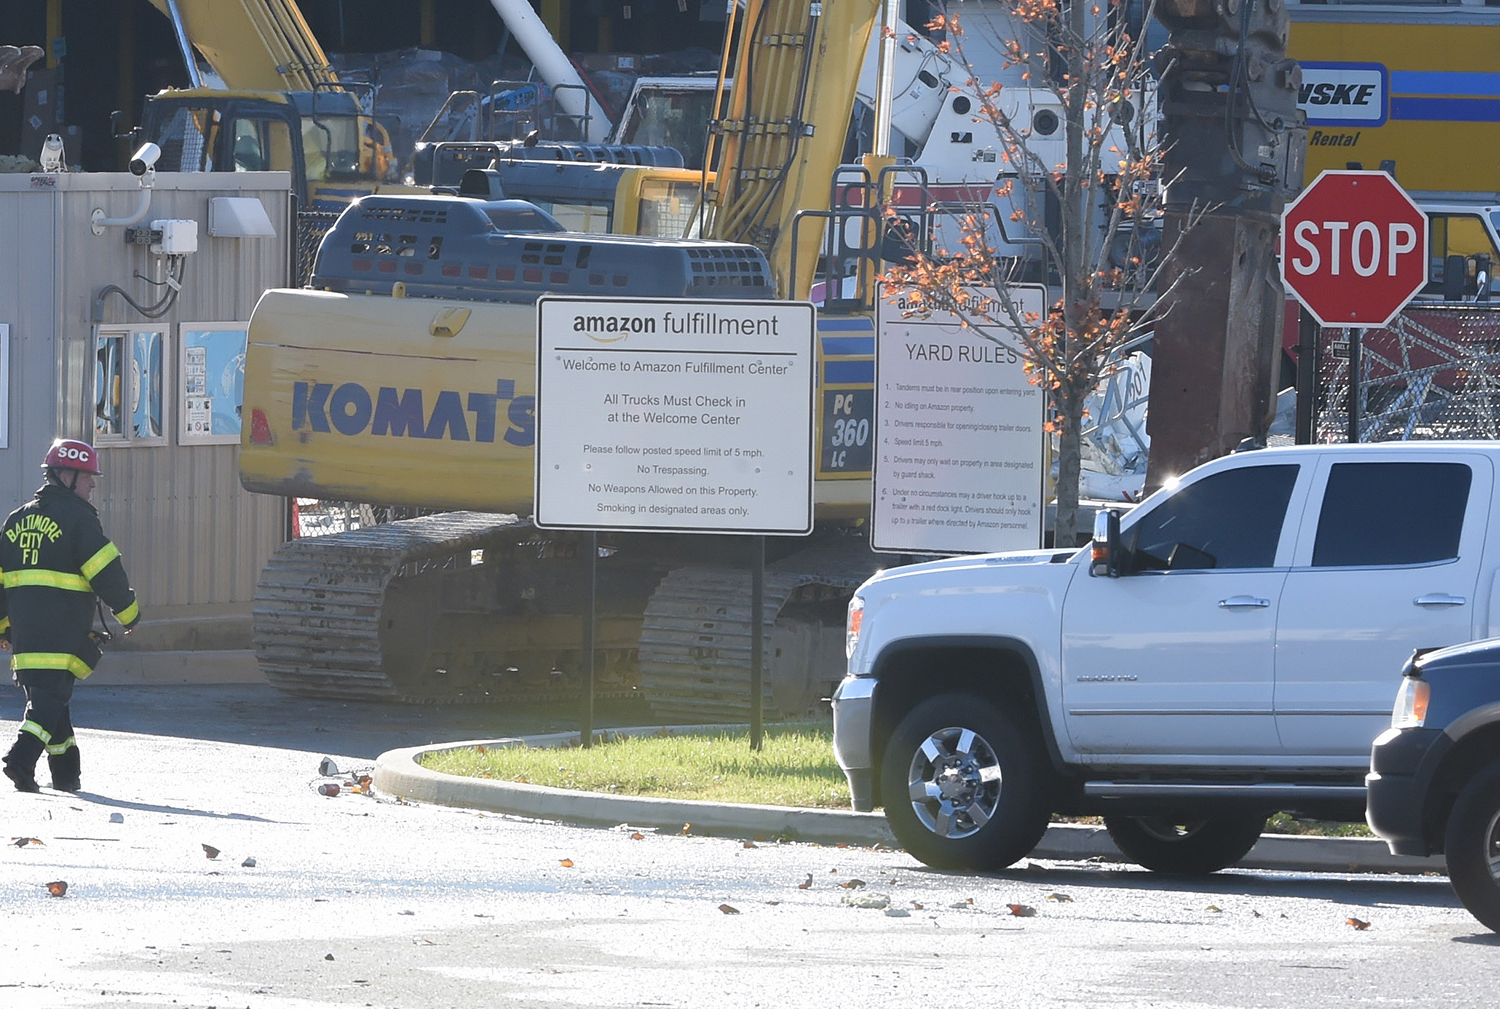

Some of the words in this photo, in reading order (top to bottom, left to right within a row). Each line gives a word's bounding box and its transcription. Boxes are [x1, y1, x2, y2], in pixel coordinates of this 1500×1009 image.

[1309, 131, 1361, 146] Rental
[1292, 220, 1417, 277] STOP
[573, 315, 656, 334] amazon
[663, 312, 778, 336] fulfillment
[906, 343, 953, 361] YARD
[959, 345, 1017, 364] RULES
[563, 359, 616, 371] Welcome
[620, 361, 631, 372] to
[633, 361, 681, 373] Amazon
[685, 362, 744, 374] Fulfillment
[748, 363, 788, 375] Center
[604, 394, 618, 405] All
[622, 395, 660, 406] Trucks
[664, 395, 692, 407] Must
[695, 396, 732, 407] Check
[736, 396, 746, 408] in
[833, 394, 853, 414] PC
[895, 401, 903, 409] No
[904, 402, 919, 411] idling
[292, 379, 535, 447] KOMATS
[607, 412, 620, 423] at
[622, 412, 640, 423] the
[643, 412, 697, 424] Welcome
[702, 413, 740, 425] Center
[895, 419, 914, 427] Drivers
[915, 421, 946, 430] responsible
[832, 419, 869, 447] 360
[894, 438, 911, 447] Speed
[58, 447, 90, 463] SOC
[583, 444, 613, 454] Please
[615, 445, 640, 455] follow
[643, 446, 672, 458] posted
[674, 446, 701, 458] speed
[703, 447, 722, 456] limit
[723, 447, 733, 457] of
[734, 448, 740, 457] 5
[742, 448, 764, 460] mph.
[831, 450, 846, 468] LC
[893, 456, 913, 464] Drivers
[637, 464, 650, 474] No
[653, 465, 709, 477] Trespassing.
[588, 483, 601, 493] No
[603, 484, 646, 496] Weapons
[648, 484, 683, 494] Allowed
[685, 486, 697, 495] on
[699, 485, 716, 495] this
[718, 486, 758, 498] Property.
[597, 503, 636, 515] Smoking
[638, 503, 647, 513] in
[649, 504, 698, 516] designated
[700, 506, 726, 515] areas
[729, 506, 749, 517] only.
[965, 505, 985, 514] Drivers
[5, 514, 63, 543] BALTIMORE
[19, 532, 44, 549] CITY
